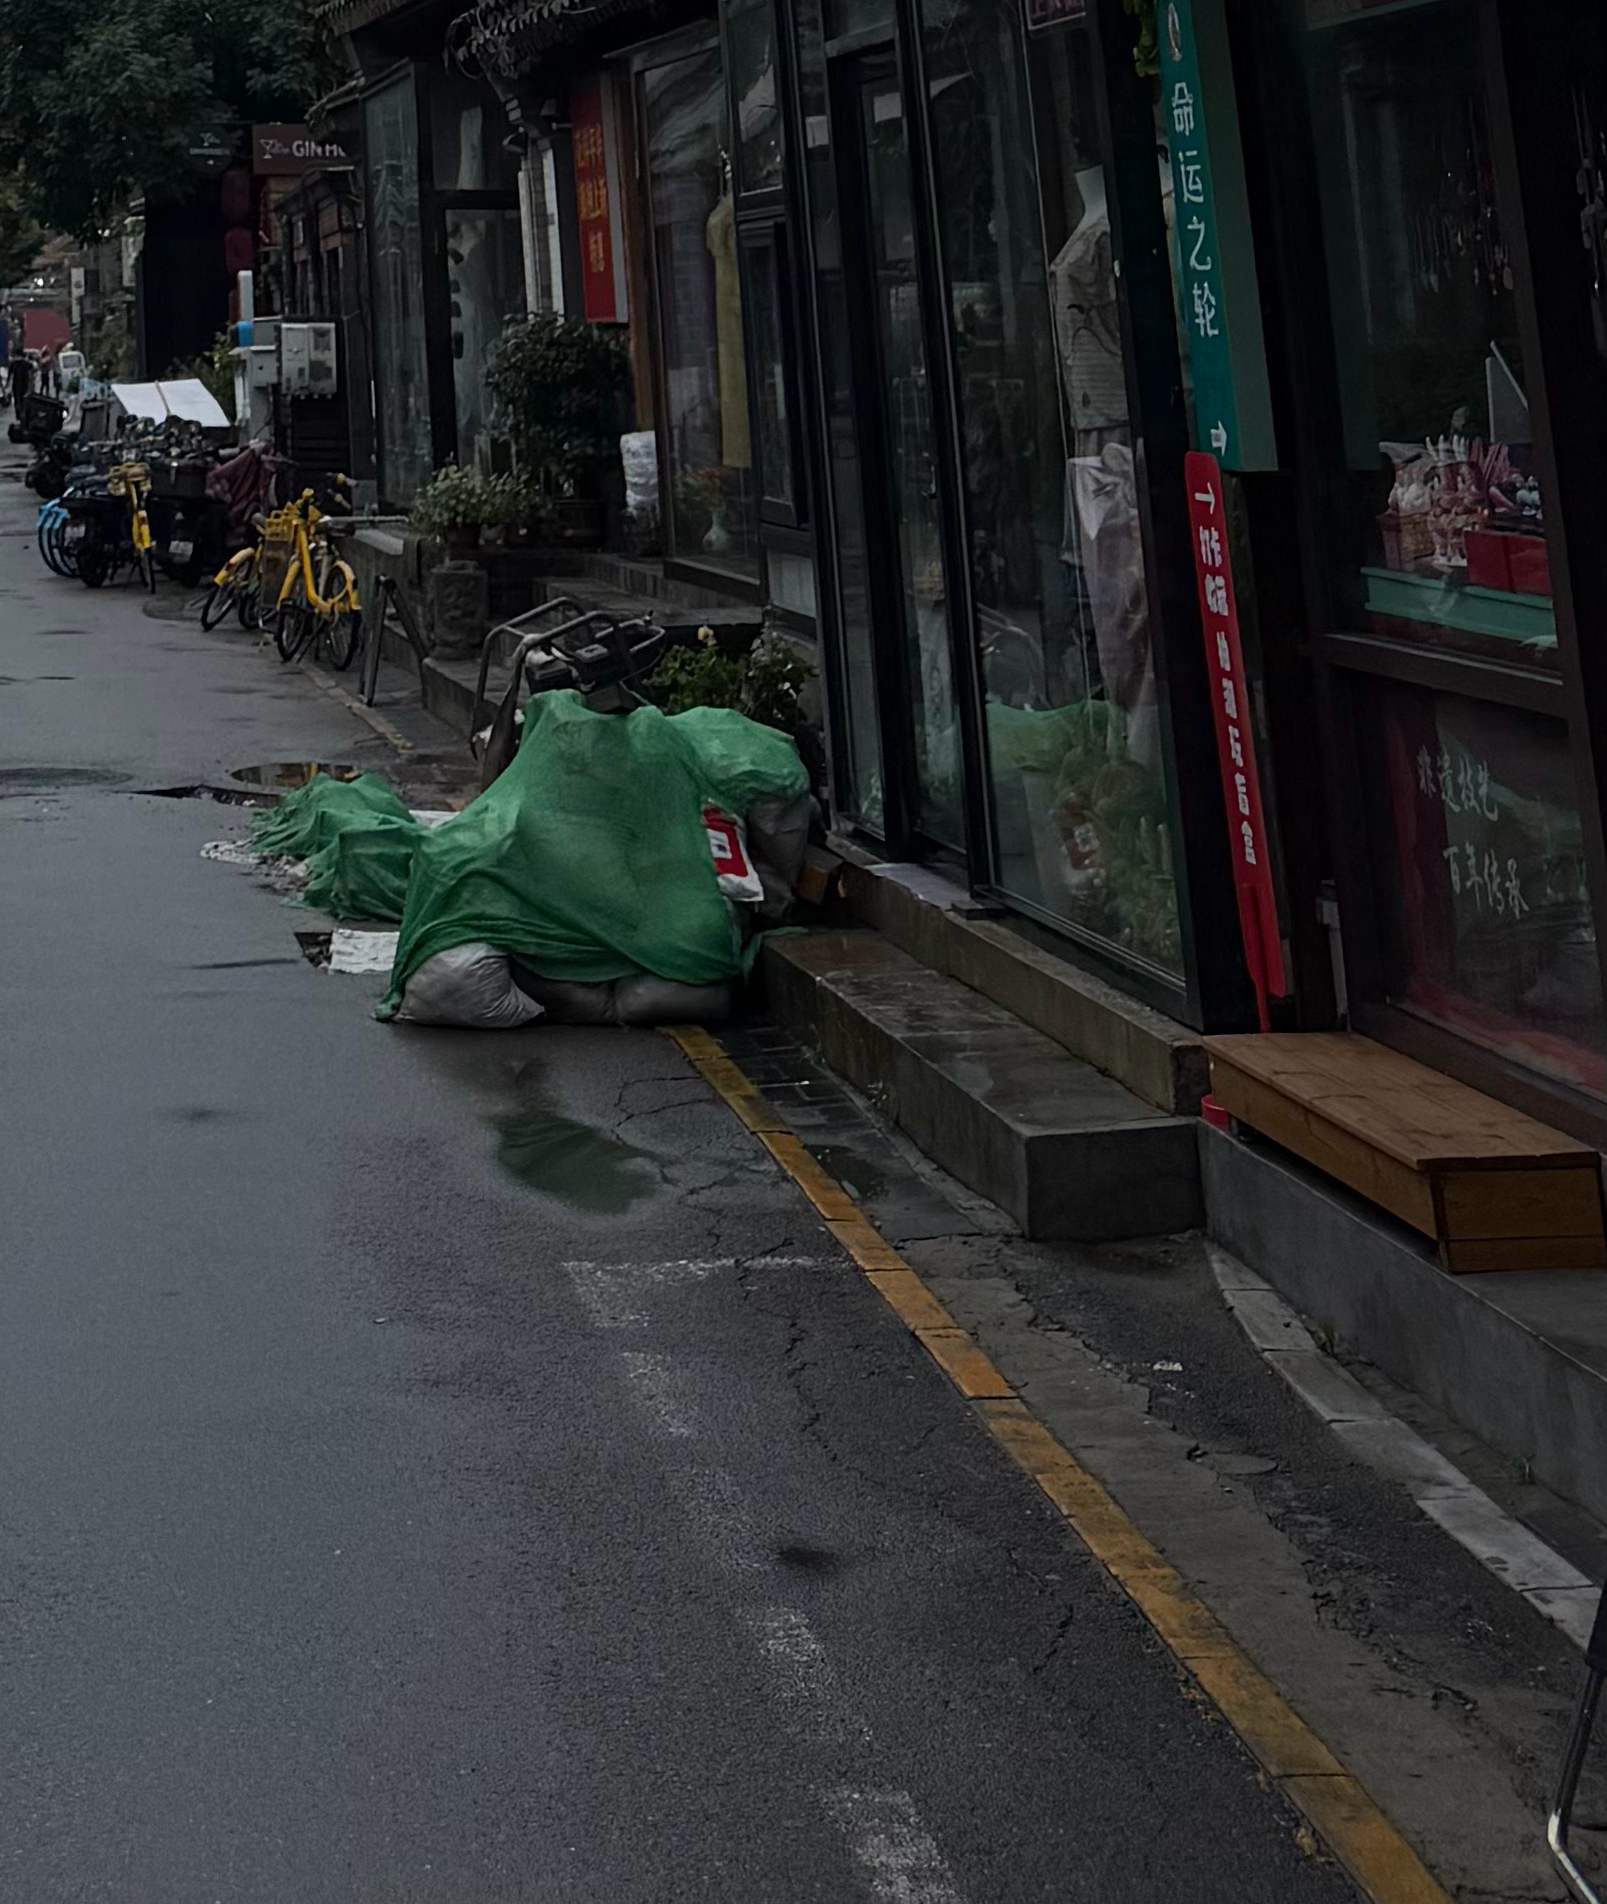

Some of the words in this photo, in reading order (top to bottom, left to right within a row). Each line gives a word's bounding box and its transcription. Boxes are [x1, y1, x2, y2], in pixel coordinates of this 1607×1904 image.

[291, 140, 322, 158] GIN
[1171, 81, 1220, 338] 命运之轮
[1443, 842, 1530, 920] 百年传承
